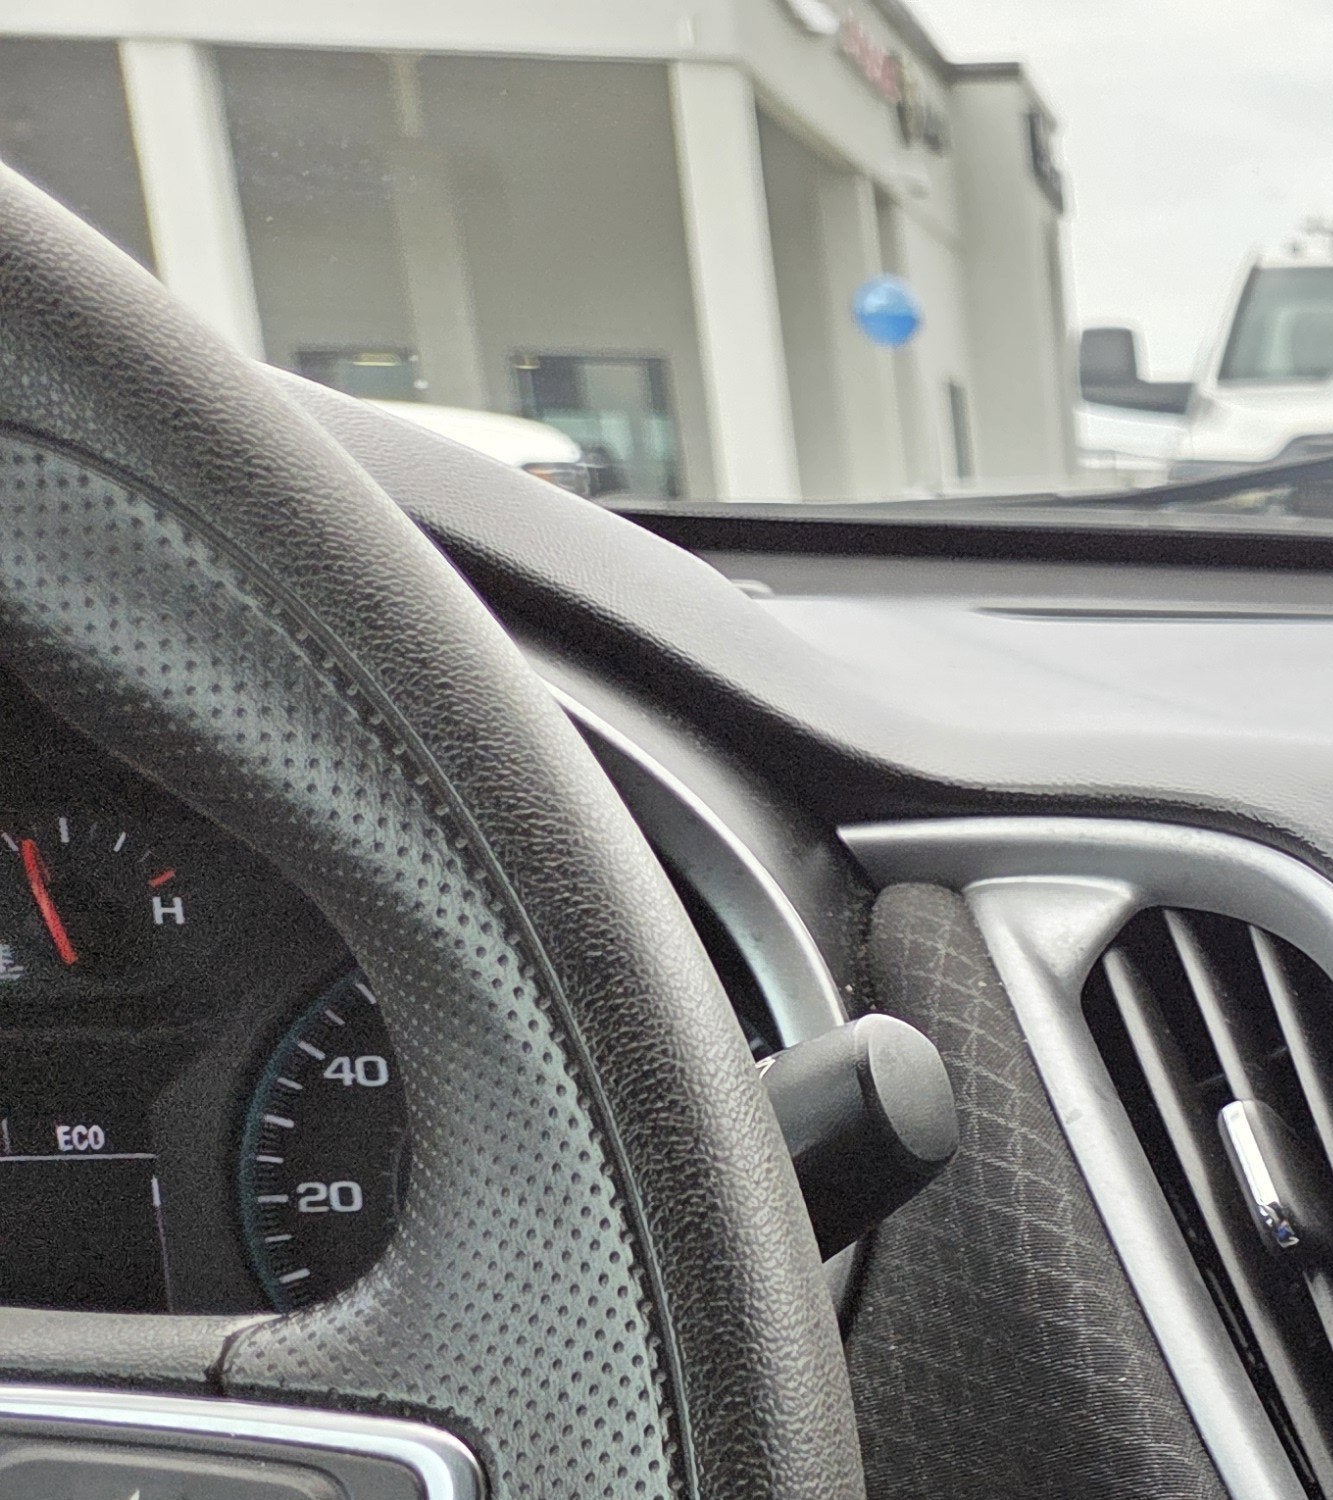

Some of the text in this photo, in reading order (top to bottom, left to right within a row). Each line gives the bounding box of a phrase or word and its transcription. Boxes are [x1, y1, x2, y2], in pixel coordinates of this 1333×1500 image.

[152, 896, 185, 925] H
[323, 1055, 389, 1087] 40
[56, 1124, 105, 1151] ECO
[297, 1181, 363, 1213] 20
